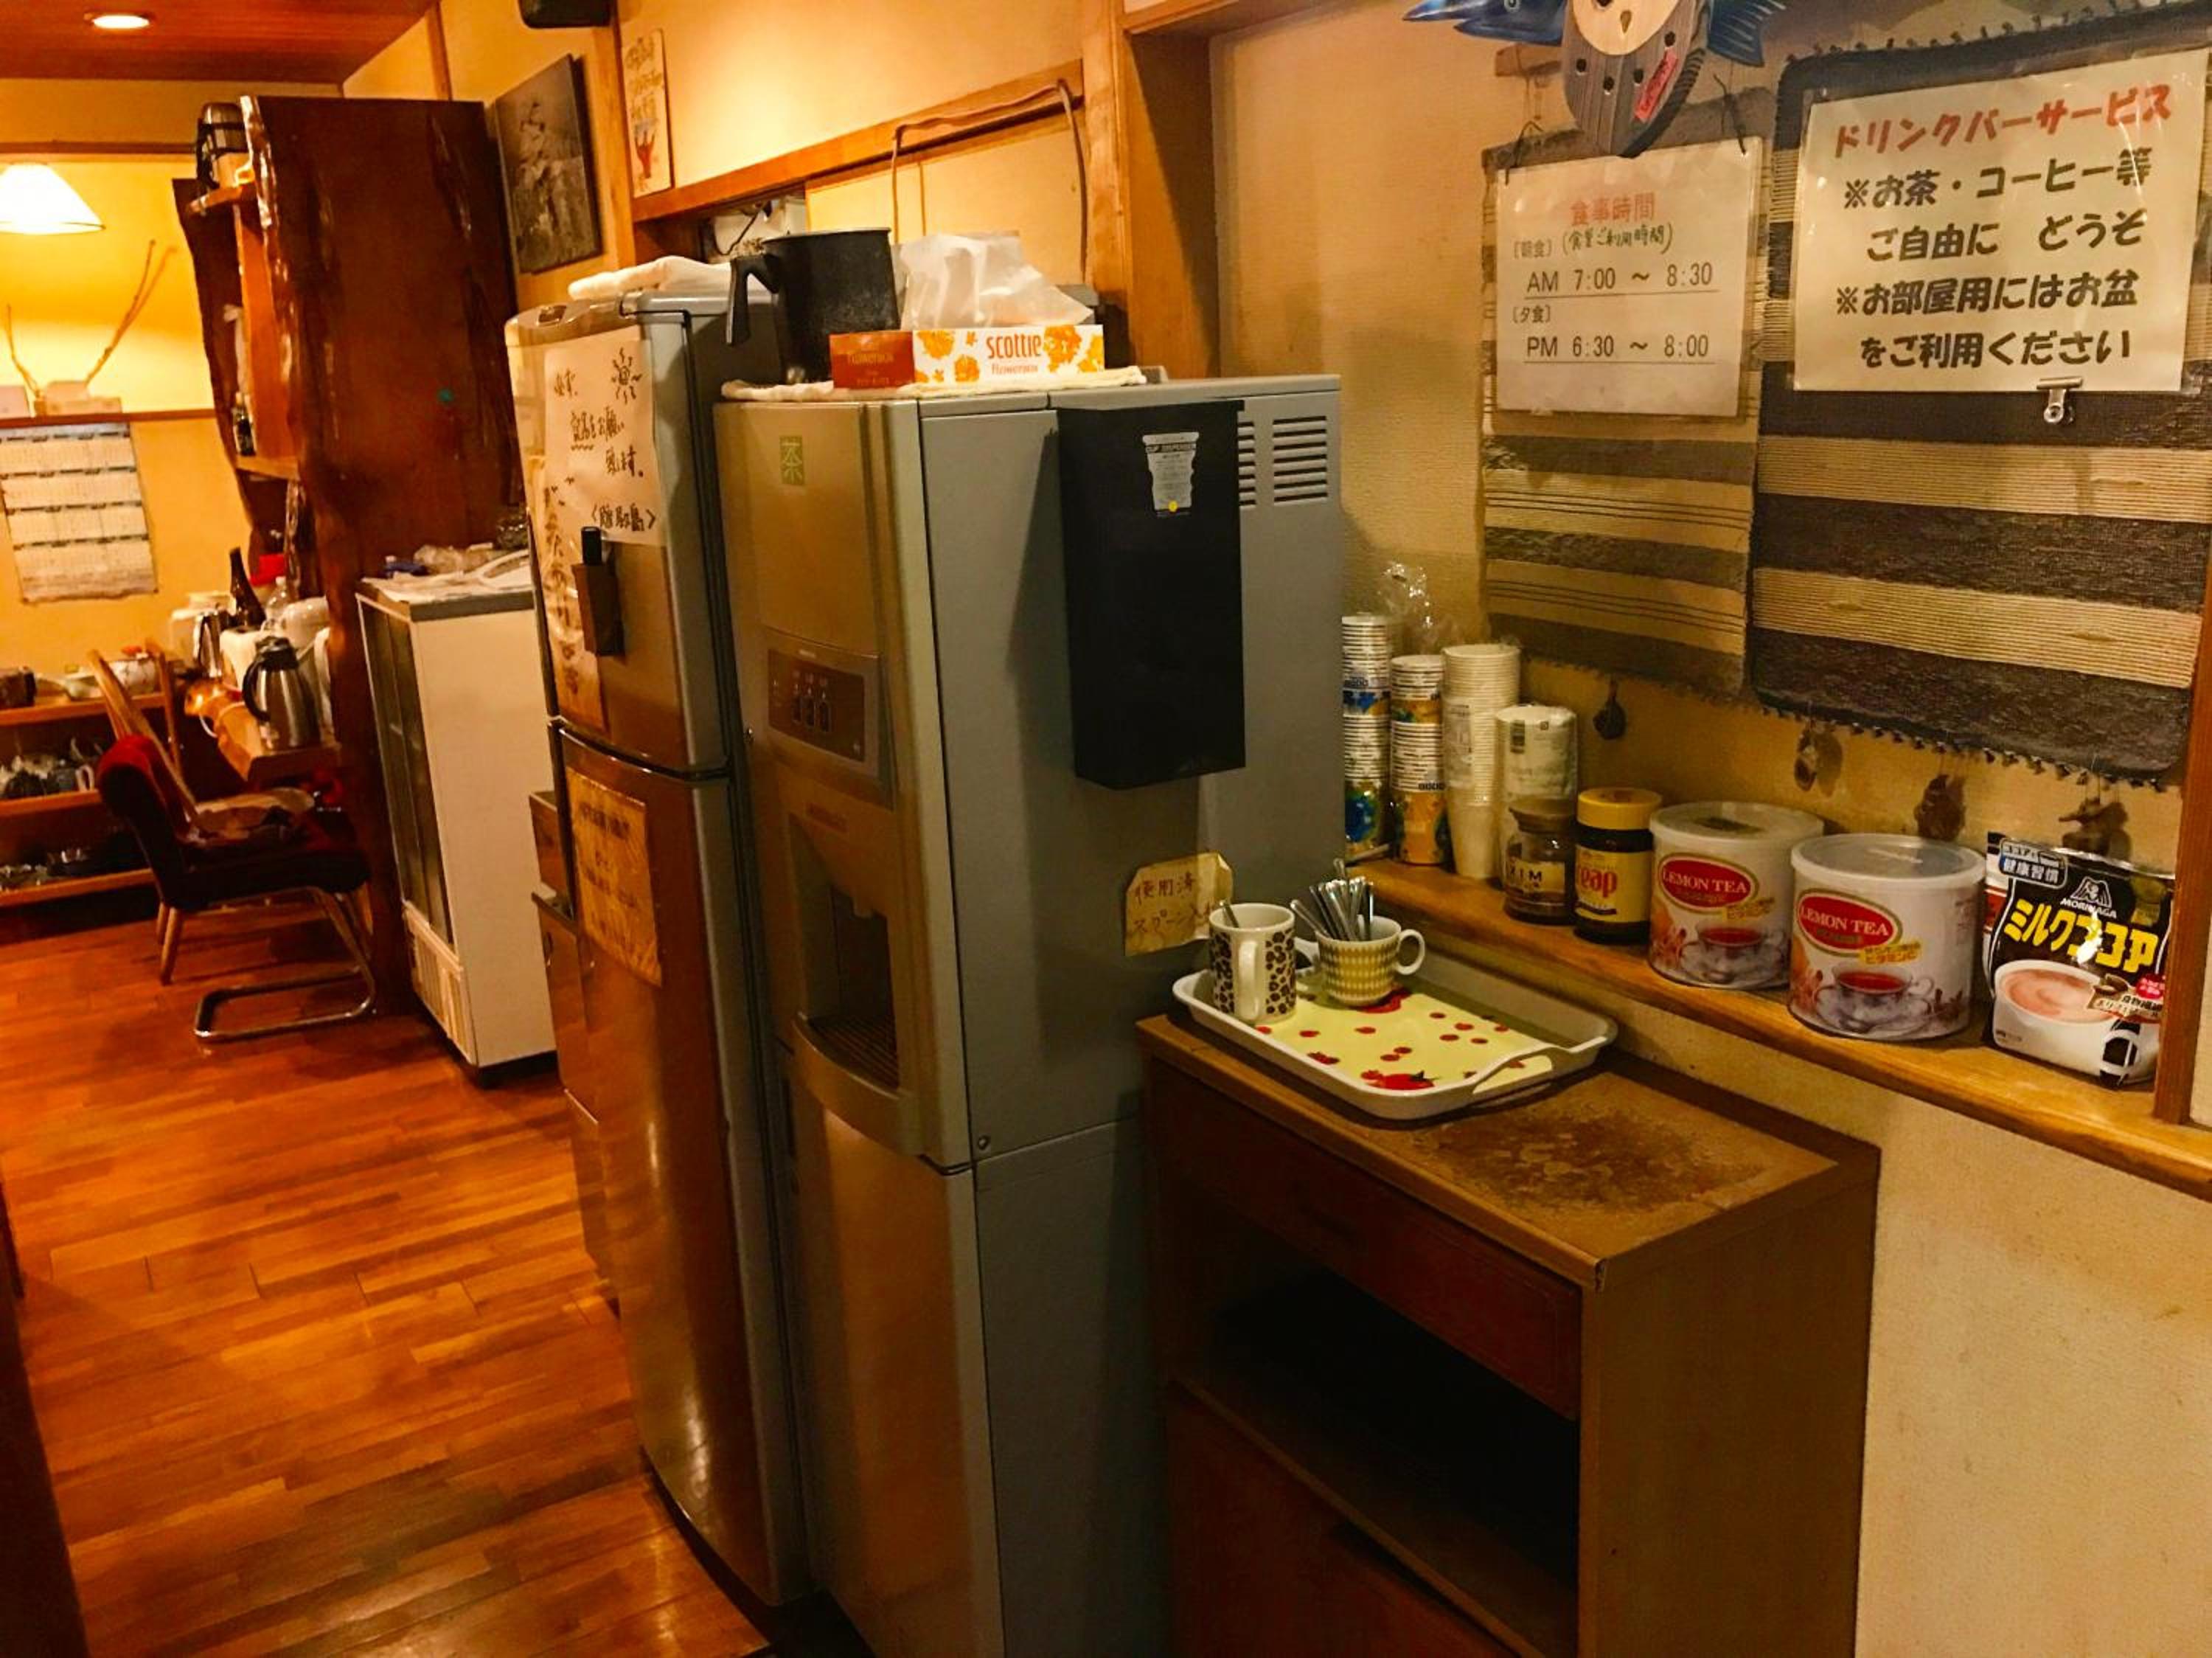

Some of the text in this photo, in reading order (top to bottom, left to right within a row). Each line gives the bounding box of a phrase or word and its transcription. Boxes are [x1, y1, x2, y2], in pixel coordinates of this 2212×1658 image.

[1835, 83, 2172, 158] ドリンクバーサービス
[1844, 147, 2153, 209] ※お茶・コーヒー等
[1570, 192, 1656, 226] 食事時間
[1866, 207, 2149, 262] ご自由に どうぞ
[1526, 271, 1559, 293] AM
[1573, 267, 1616, 291] 7:00
[1666, 262, 1714, 287] 8:30
[1836, 268, 2140, 316] ※お部屋用にはお盆
[986, 332, 1042, 359] scottie
[1526, 337, 1558, 357] PM
[1573, 335, 1615, 358] 6:30
[1664, 334, 1709, 358] 8:00
[1860, 330, 2131, 370] をご利用ください
[1663, 870, 1747, 893] LEMON TEA
[1801, 906, 1848, 931] LEMON
[1850, 919, 1890, 937] TEA
[2060, 898, 2118, 919] MORINAGA
[2003, 898, 2159, 973] ミルクココア
